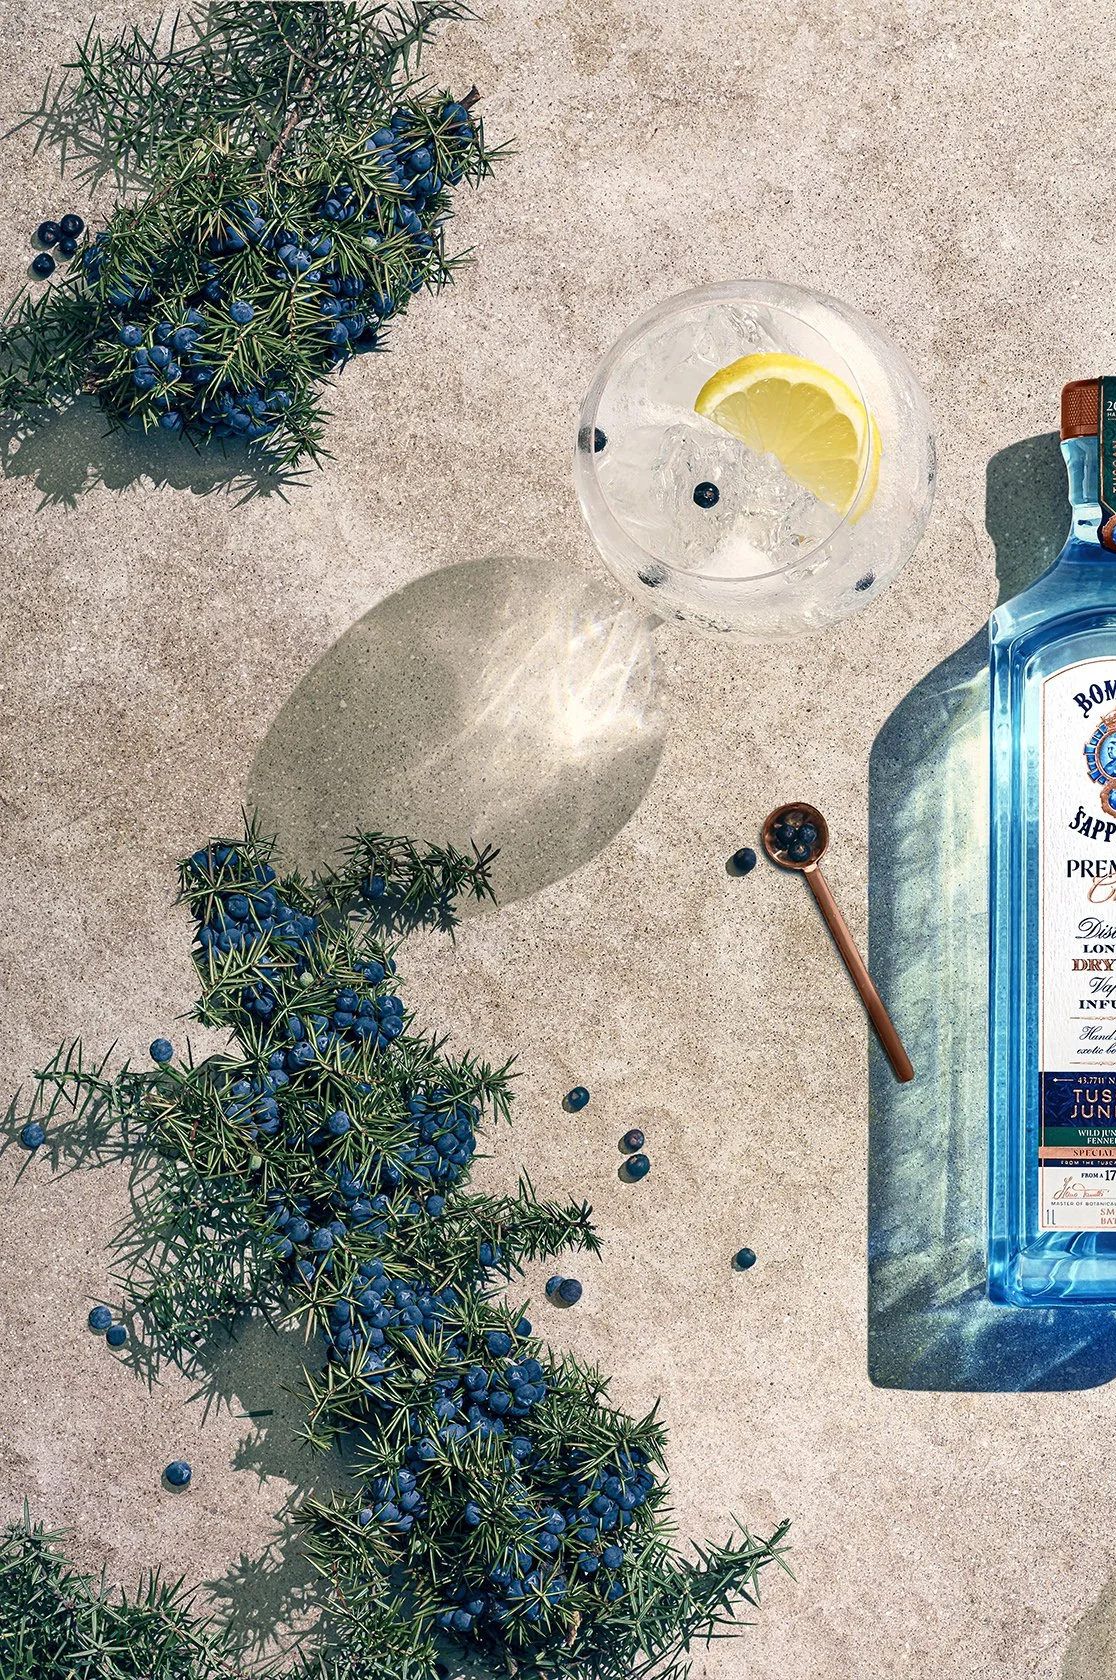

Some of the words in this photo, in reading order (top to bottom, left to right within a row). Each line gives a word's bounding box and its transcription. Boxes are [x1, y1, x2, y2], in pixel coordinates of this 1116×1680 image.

[1072, 958, 1116, 971] DRY
[1079, 1026, 1115, 1040] Hand
[1077, 1044, 1103, 1054] exotic
[1052, 1209, 1056, 1225] L
